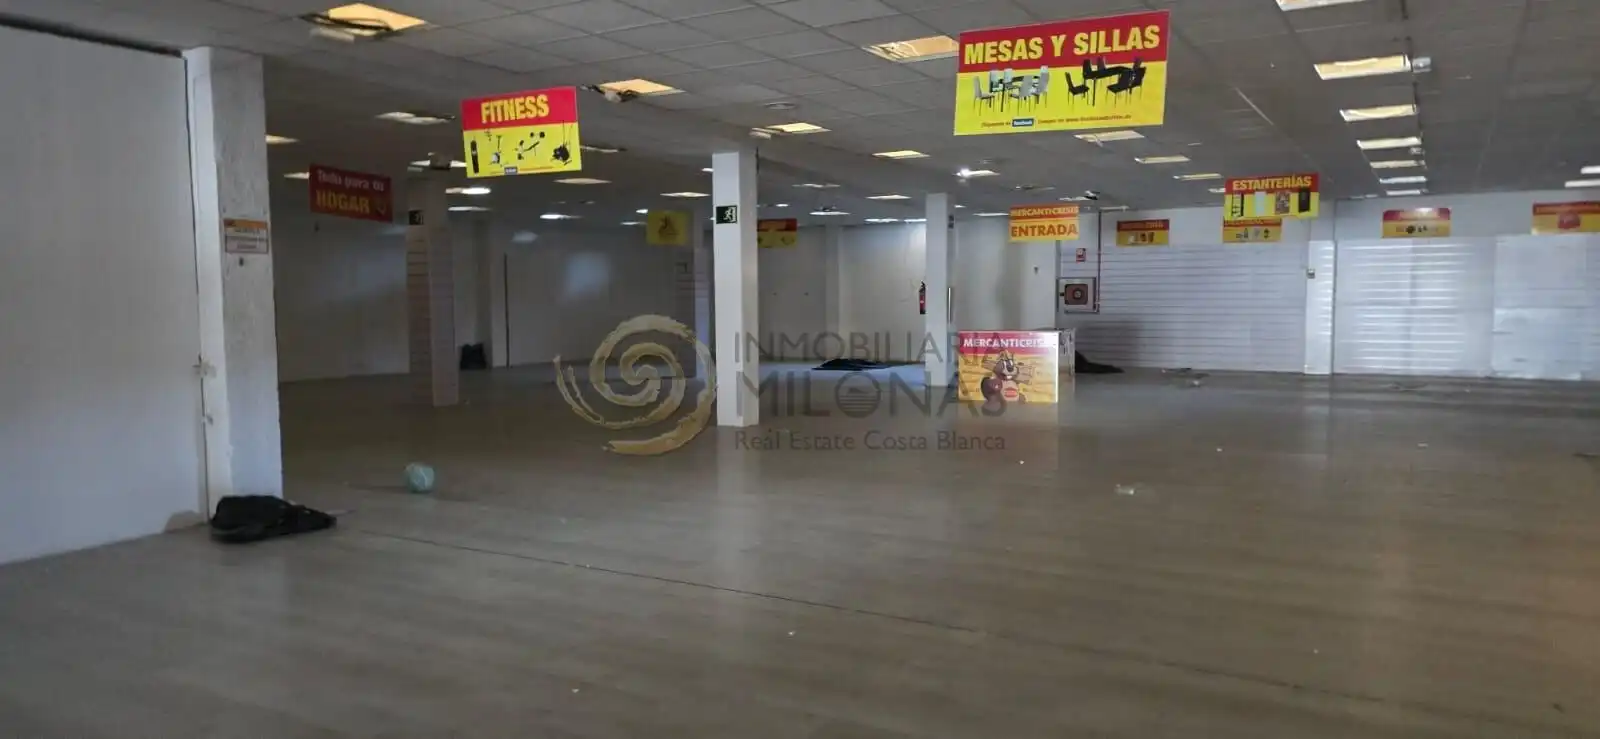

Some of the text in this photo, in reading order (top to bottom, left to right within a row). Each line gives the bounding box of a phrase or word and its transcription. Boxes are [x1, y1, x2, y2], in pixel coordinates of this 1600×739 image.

[964, 24, 1161, 65] MESAS Y SILLAS
[481, 94, 550, 124] FITNESS
[316, 168, 385, 192] Todo para tu
[1232, 174, 1312, 191] ESTANTERÍAS
[315, 189, 370, 215] HOGAR
[1011, 223, 1079, 238] ENTRADA
